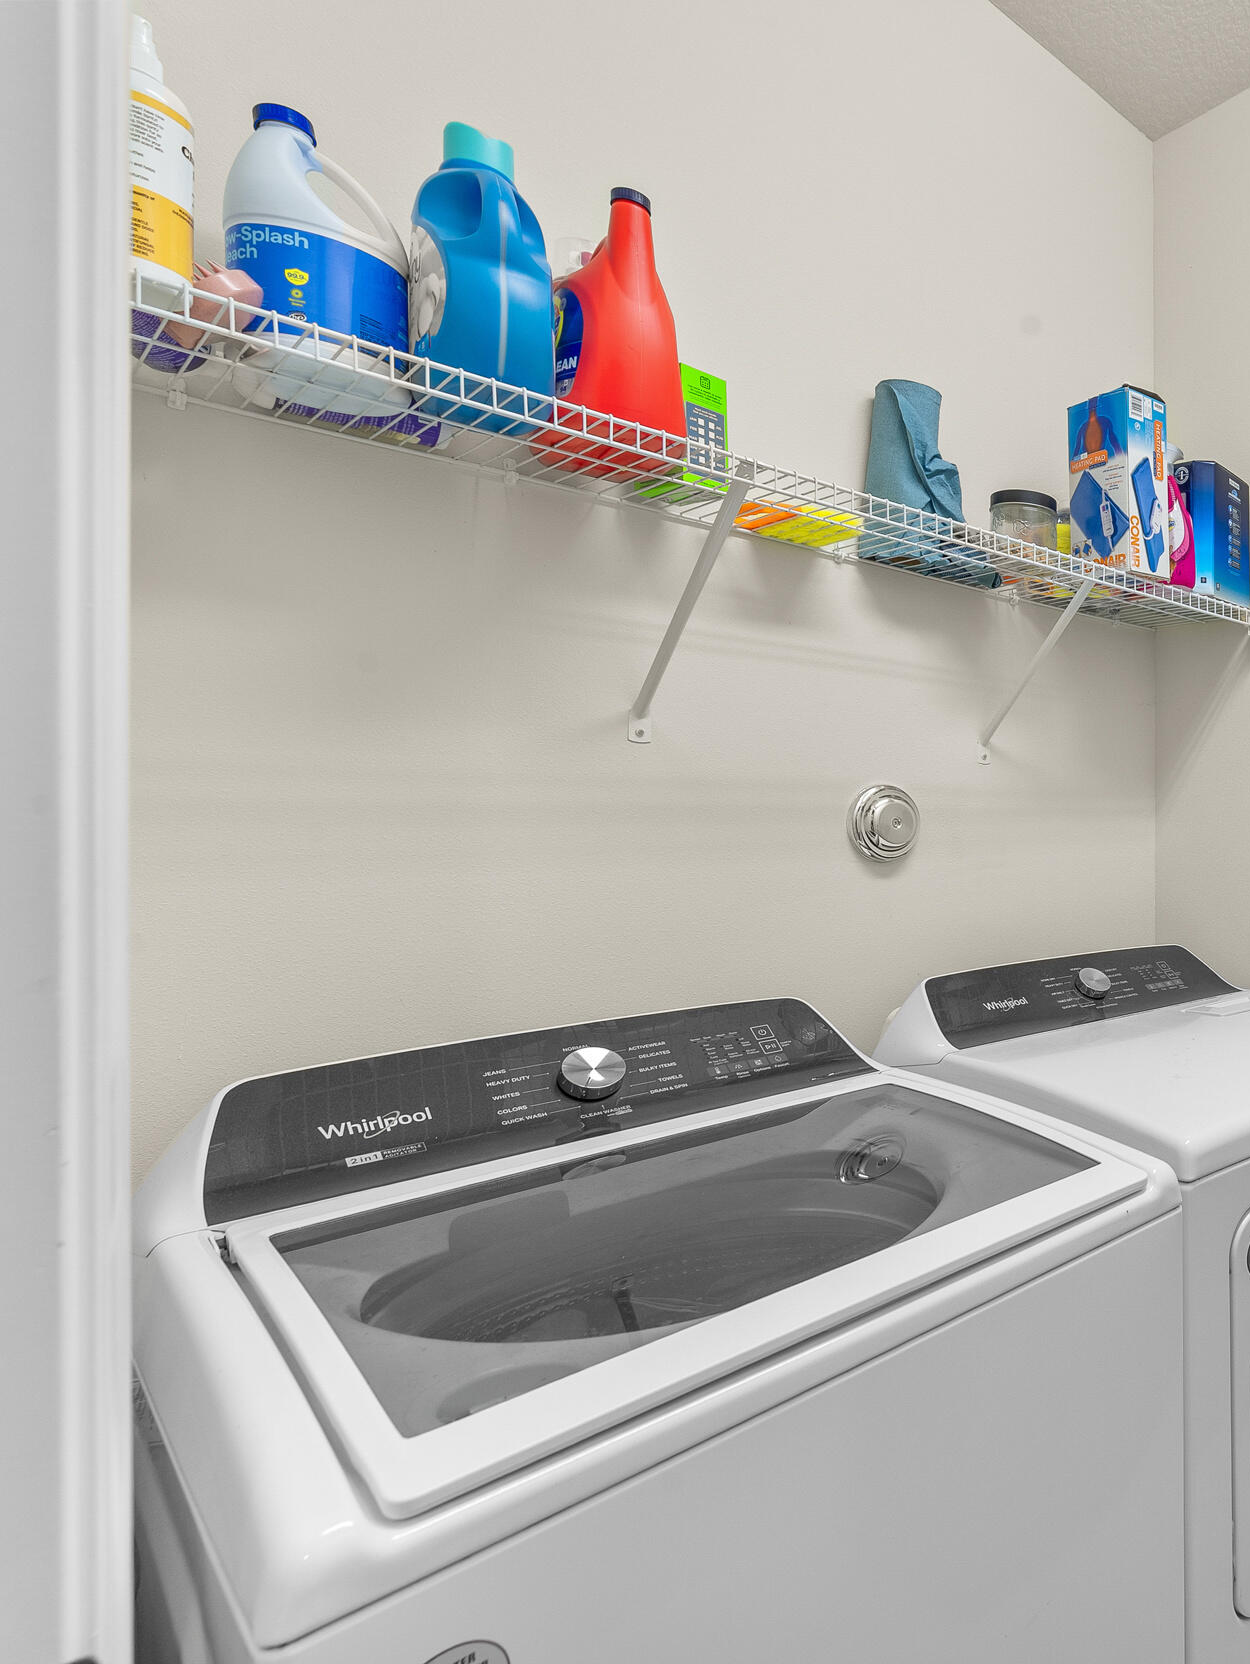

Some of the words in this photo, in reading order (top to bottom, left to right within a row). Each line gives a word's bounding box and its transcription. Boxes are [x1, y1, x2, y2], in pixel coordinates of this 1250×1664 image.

[226, 226, 309, 249] w-Splash
[227, 243, 258, 262] each
[556, 356, 578, 373] EAN
[1071, 456, 1093, 470] HEATING
[1094, 454, 1106, 463] PAD
[1130, 515, 1140, 568] CONAIR
[982, 996, 1029, 1011] Whirlpool
[628, 1041, 666, 1051] ACTIVEWEAR
[638, 1049, 671, 1059] DELICATES
[482, 1069, 507, 1077] JEANS
[638, 1065, 658, 1073] BULKY
[659, 1061, 678, 1069] ITEMS
[486, 1079, 510, 1087] HEAVY
[511, 1075, 531, 1083] DUTY
[658, 1073, 684, 1082] TOWELS
[491, 1091, 521, 1101] WHITES
[649, 1087, 669, 1095] DRAIN
[497, 1105, 528, 1115] COLORS
[580, 1111, 603, 1119] CLEAN
[603, 1104, 632, 1114] WASHER
[317, 1106, 433, 1139] Whirlpool
[501, 1117, 525, 1126] QUICK
[526, 1111, 548, 1120] WASH
[383, 1143, 423, 1155] REMOVABLE
[384, 1148, 417, 1159] AGITATOR
